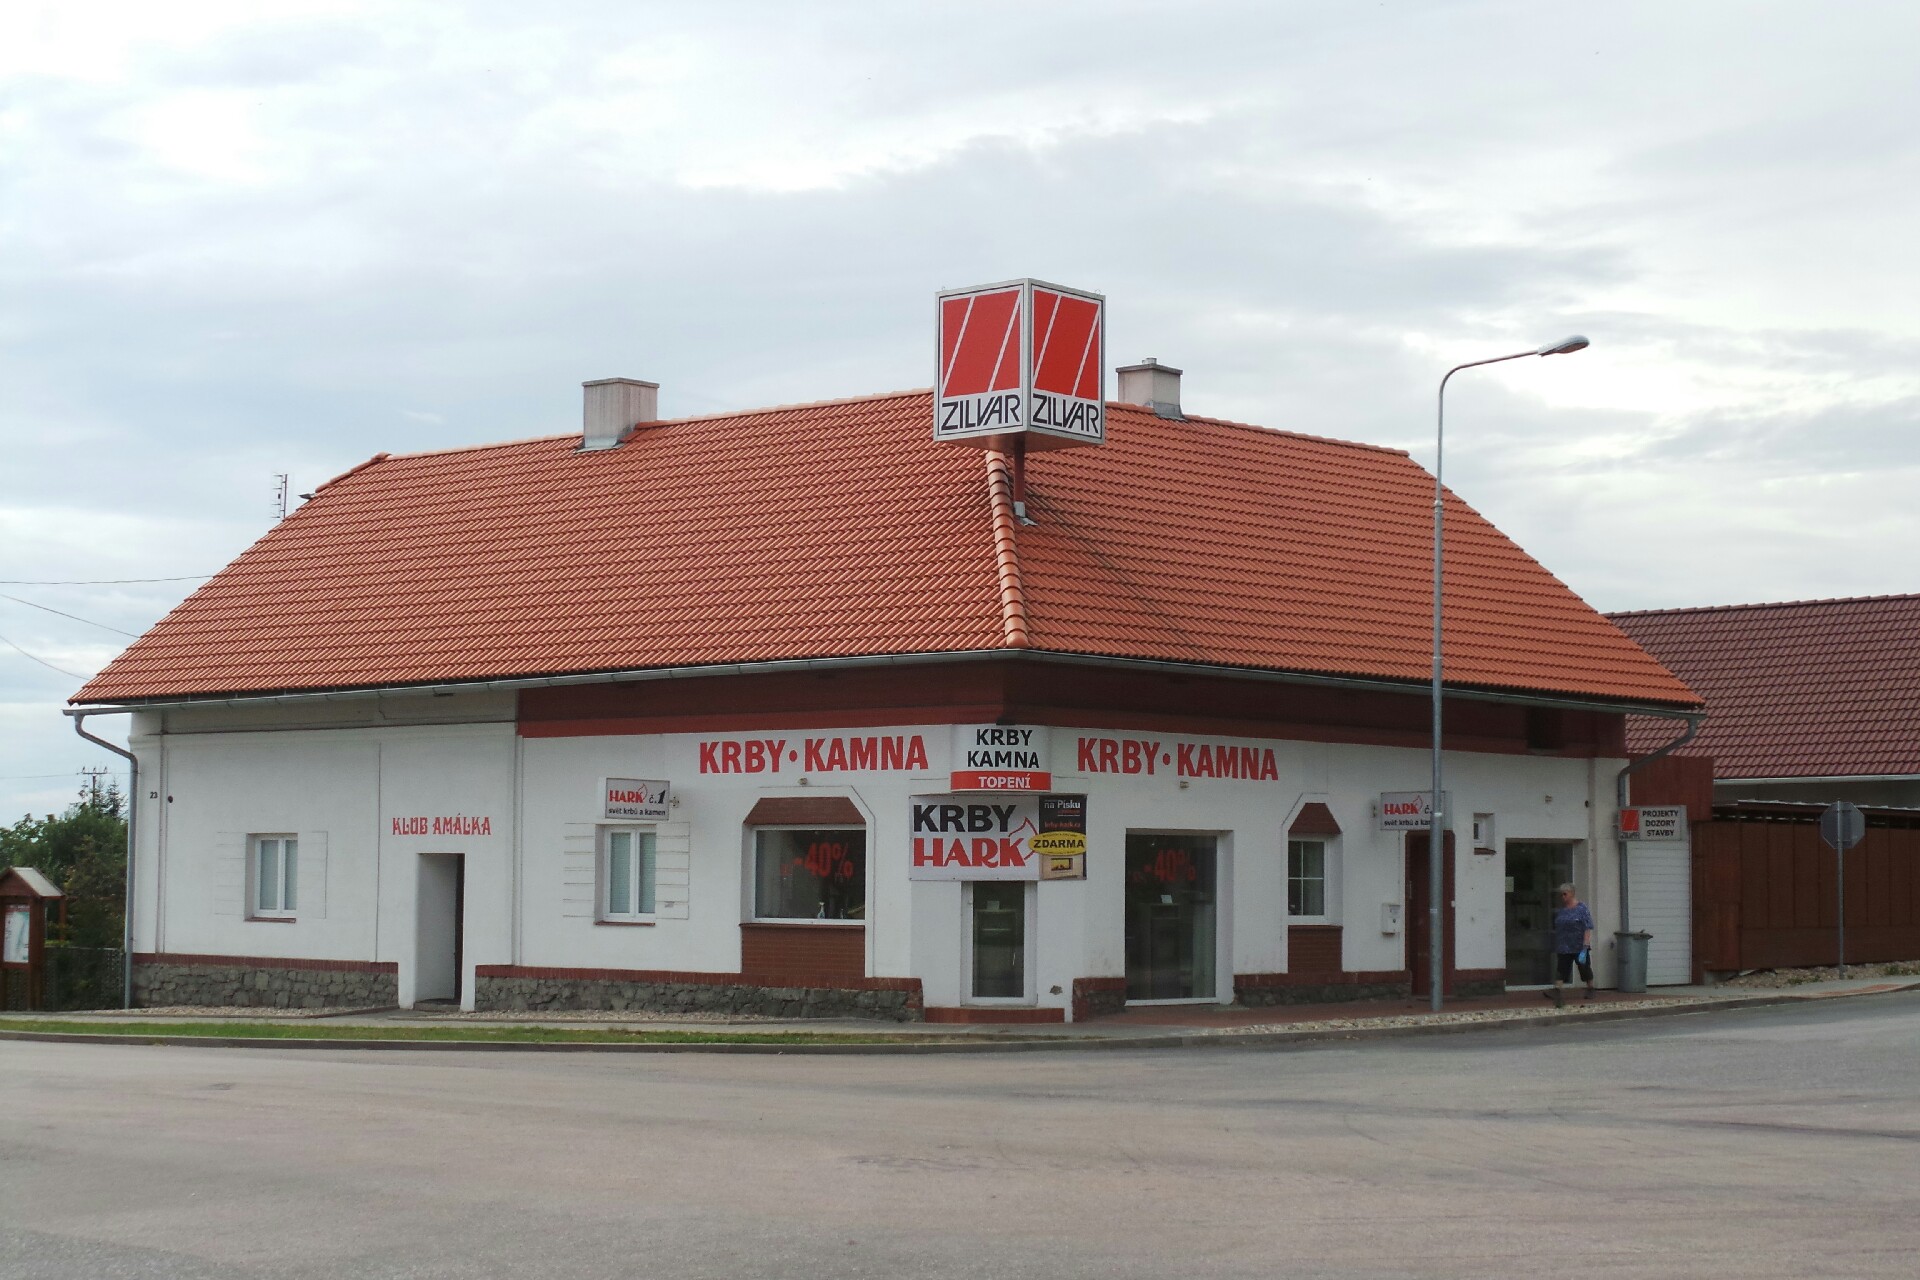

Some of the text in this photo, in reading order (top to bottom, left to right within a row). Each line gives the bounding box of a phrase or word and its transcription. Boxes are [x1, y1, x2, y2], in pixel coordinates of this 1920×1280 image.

[941, 394, 1021, 431] ZILVAR
[1032, 393, 1099, 434] ZILVAR
[976, 729, 1033, 746] KRBY
[699, 735, 929, 774] KRBY KAMNA
[967, 751, 1040, 769] KAMNA
[1078, 737, 1279, 781] KRBY KAMNA
[978, 774, 1031, 789] TOPENÍ
[150, 791, 158, 799] 23
[609, 789, 644, 804] HARK
[644, 808, 666, 816] kamen
[1384, 803, 1419, 814] HARK
[392, 812, 491, 836] KLUB AMÁLKA
[913, 804, 1017, 833] KRBY
[913, 837, 1026, 869] HARK
[1033, 839, 1085, 849] ZDARMA
